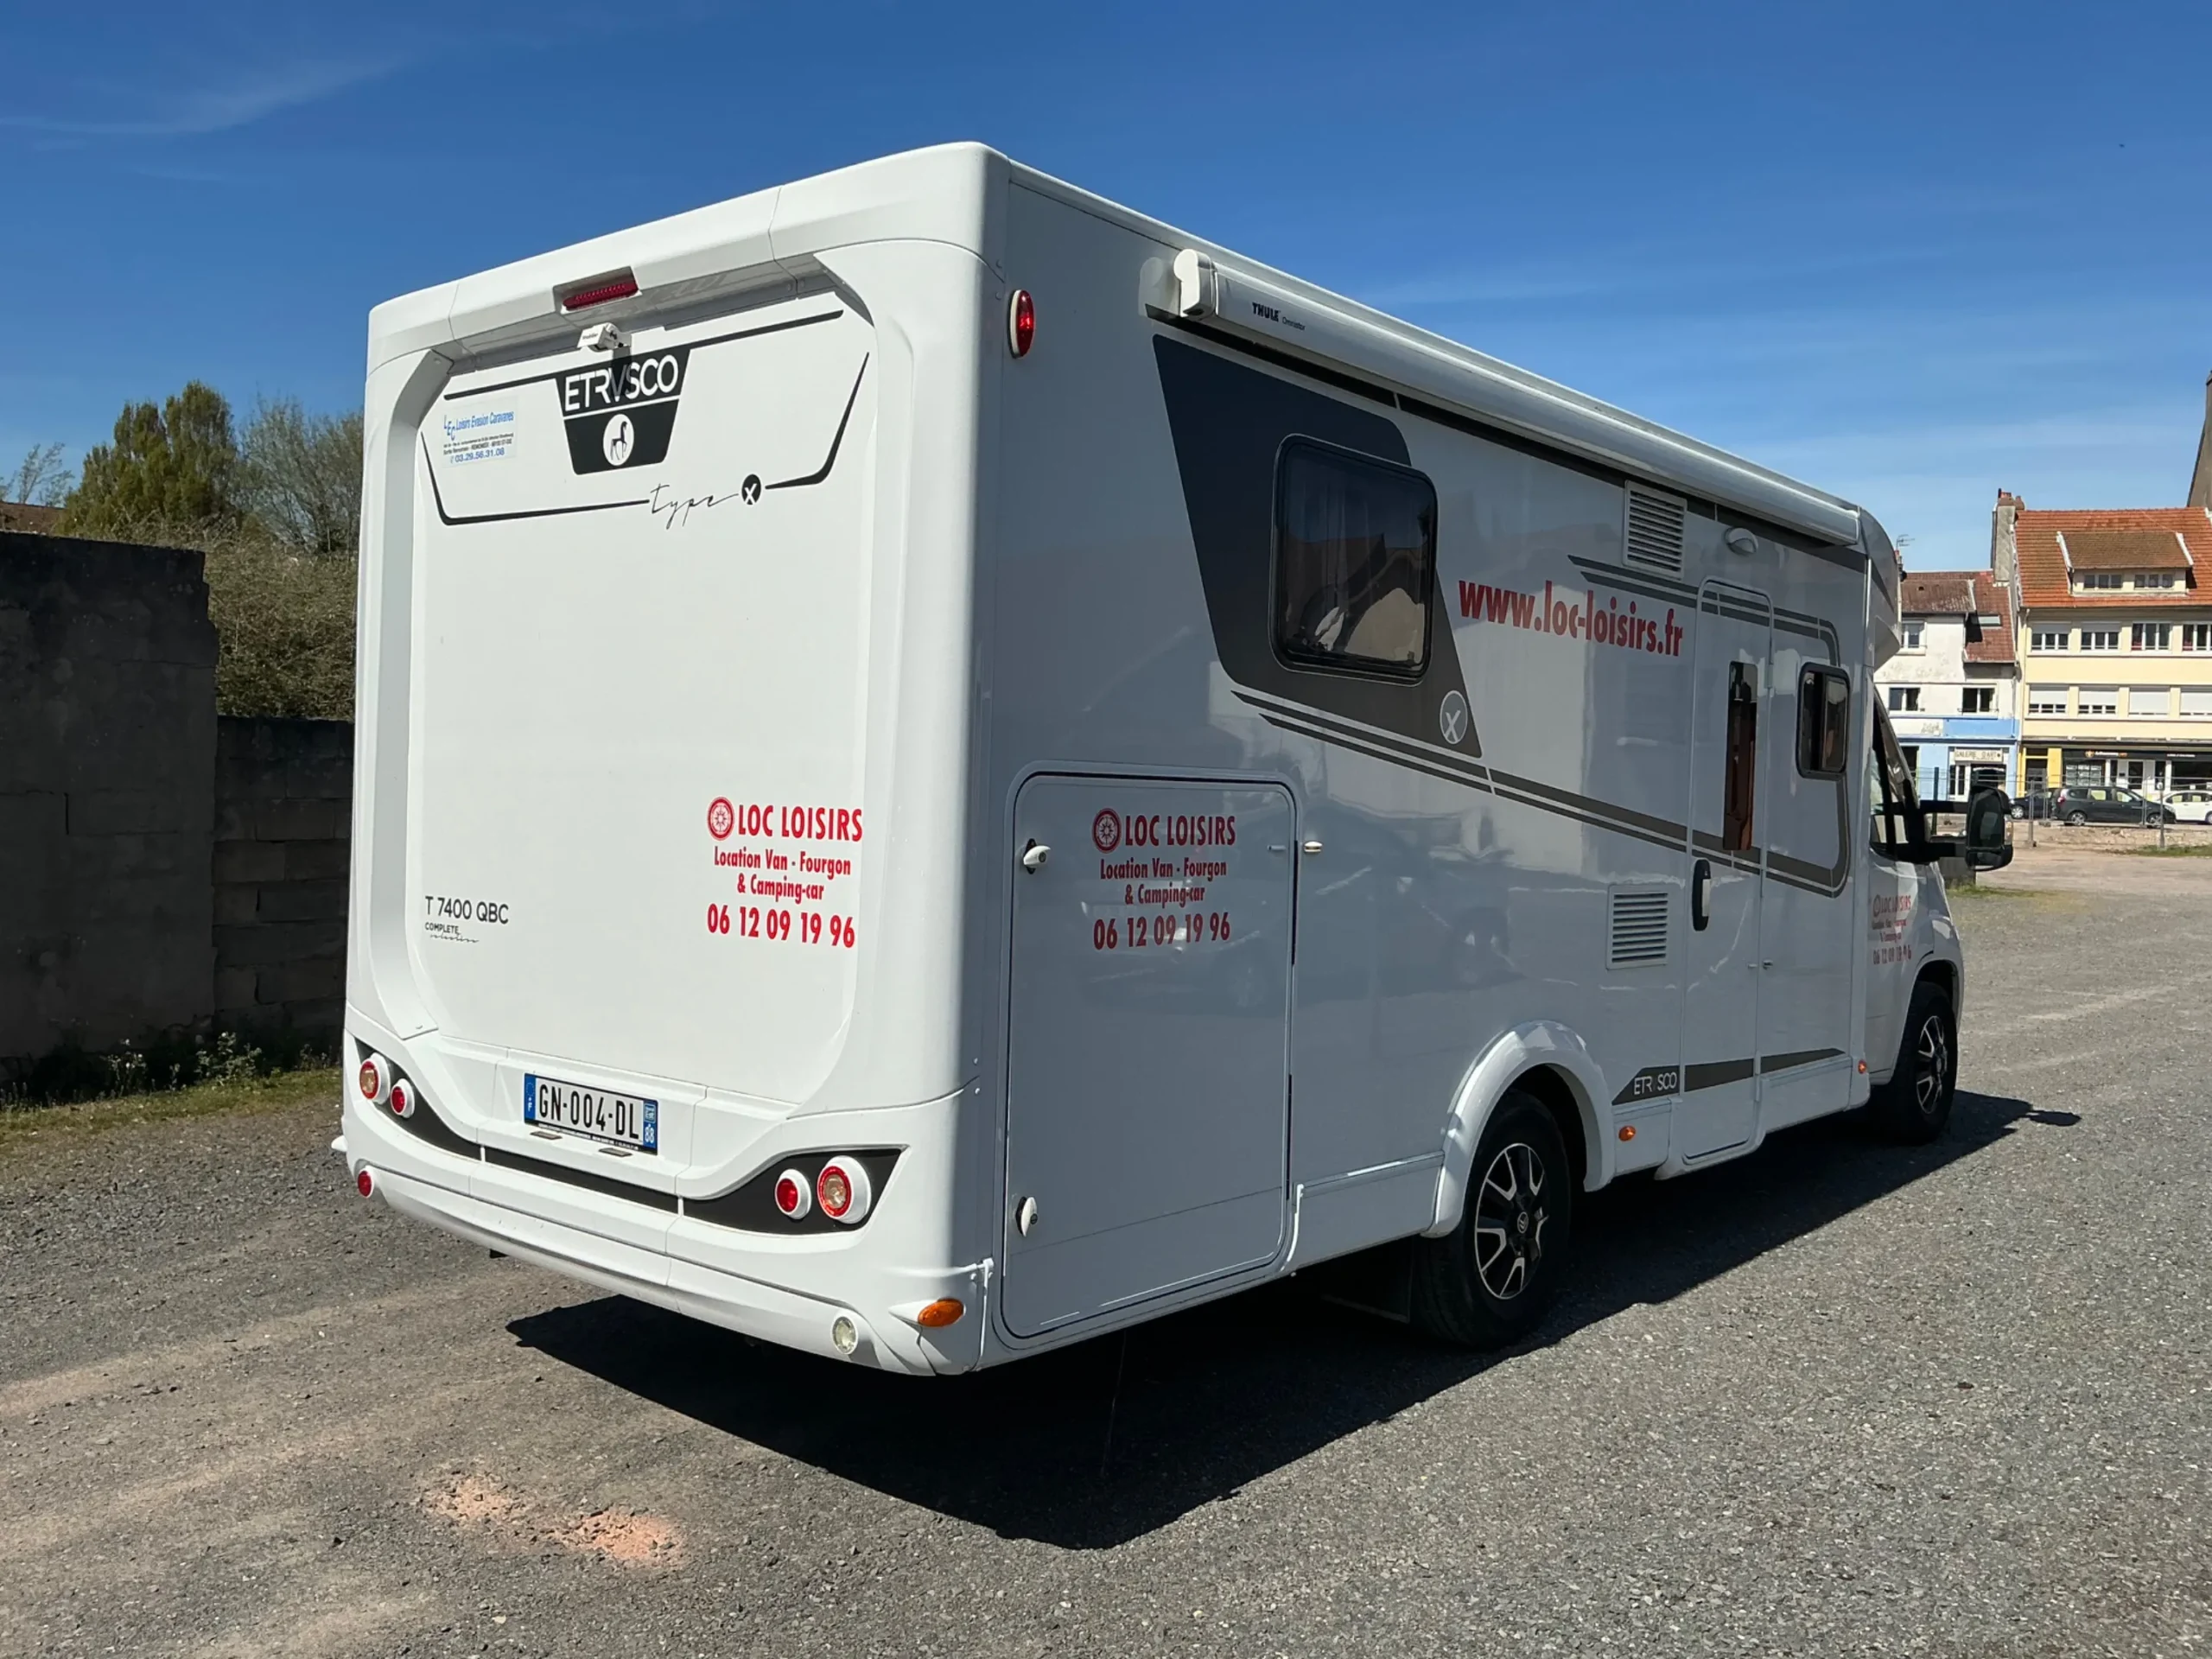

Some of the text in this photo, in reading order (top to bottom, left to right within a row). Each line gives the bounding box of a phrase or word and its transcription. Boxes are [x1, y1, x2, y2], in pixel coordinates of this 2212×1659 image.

[1252, 302, 1279, 322] THULE
[489, 411, 514, 424] Caravanes
[1459, 580, 1683, 657] www.loc-loisirs.fr
[738, 804, 863, 842] LOC LOISIRS
[1125, 815, 1236, 847] LOC LOISIRS
[714, 846, 761, 869] Location
[766, 849, 788, 871] Van
[799, 851, 851, 880] Fourgon
[1100, 857, 1148, 880] Location
[1152, 857, 1173, 878] Van
[1184, 857, 1227, 881] Fourgon
[737, 873, 824, 905] & Camping-car
[1125, 882, 1205, 908] & Camping-car
[424, 895, 509, 925] T 7400 QBC
[707, 903, 855, 948] 06 12 09 19 96
[1093, 912, 1230, 950] 06 12 09 19 96
[539, 1084, 639, 1140] GN-004-DL
